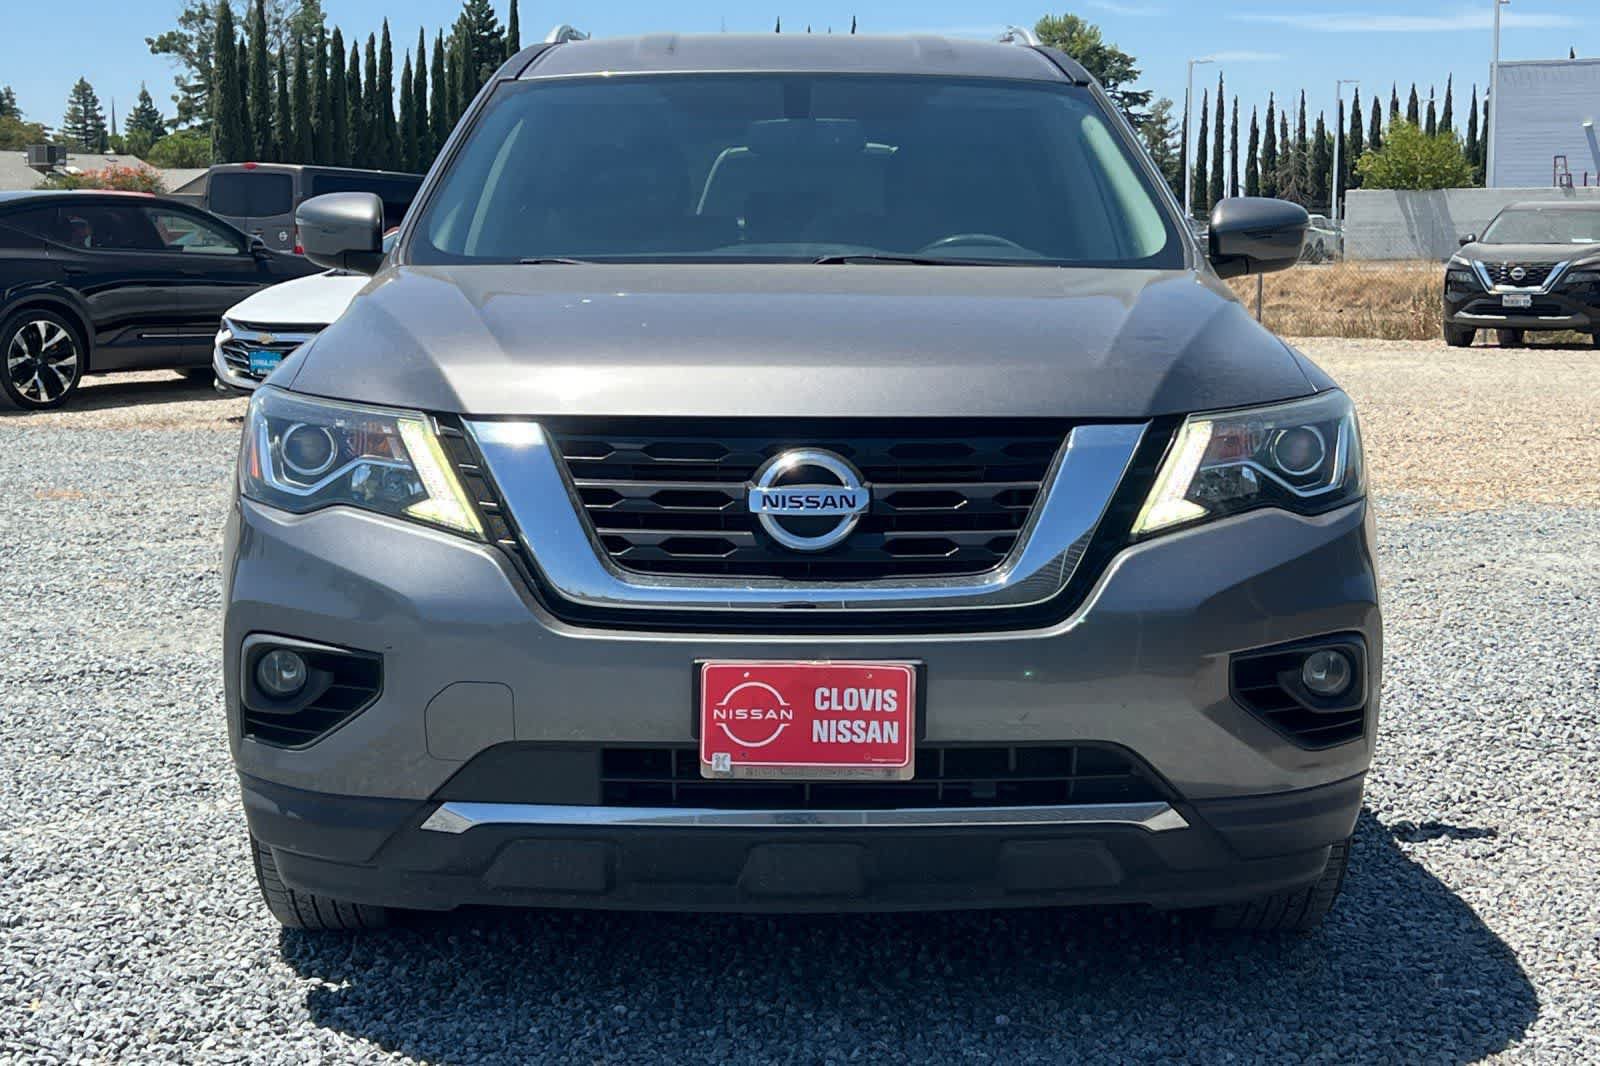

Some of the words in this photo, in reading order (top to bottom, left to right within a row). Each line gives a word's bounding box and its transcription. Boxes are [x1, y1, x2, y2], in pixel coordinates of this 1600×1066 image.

[762, 494, 856, 509] NISSAN
[814, 687, 898, 712] CLOVIS
[713, 709, 793, 720] NISSAN
[812, 719, 899, 744] NISSAN
